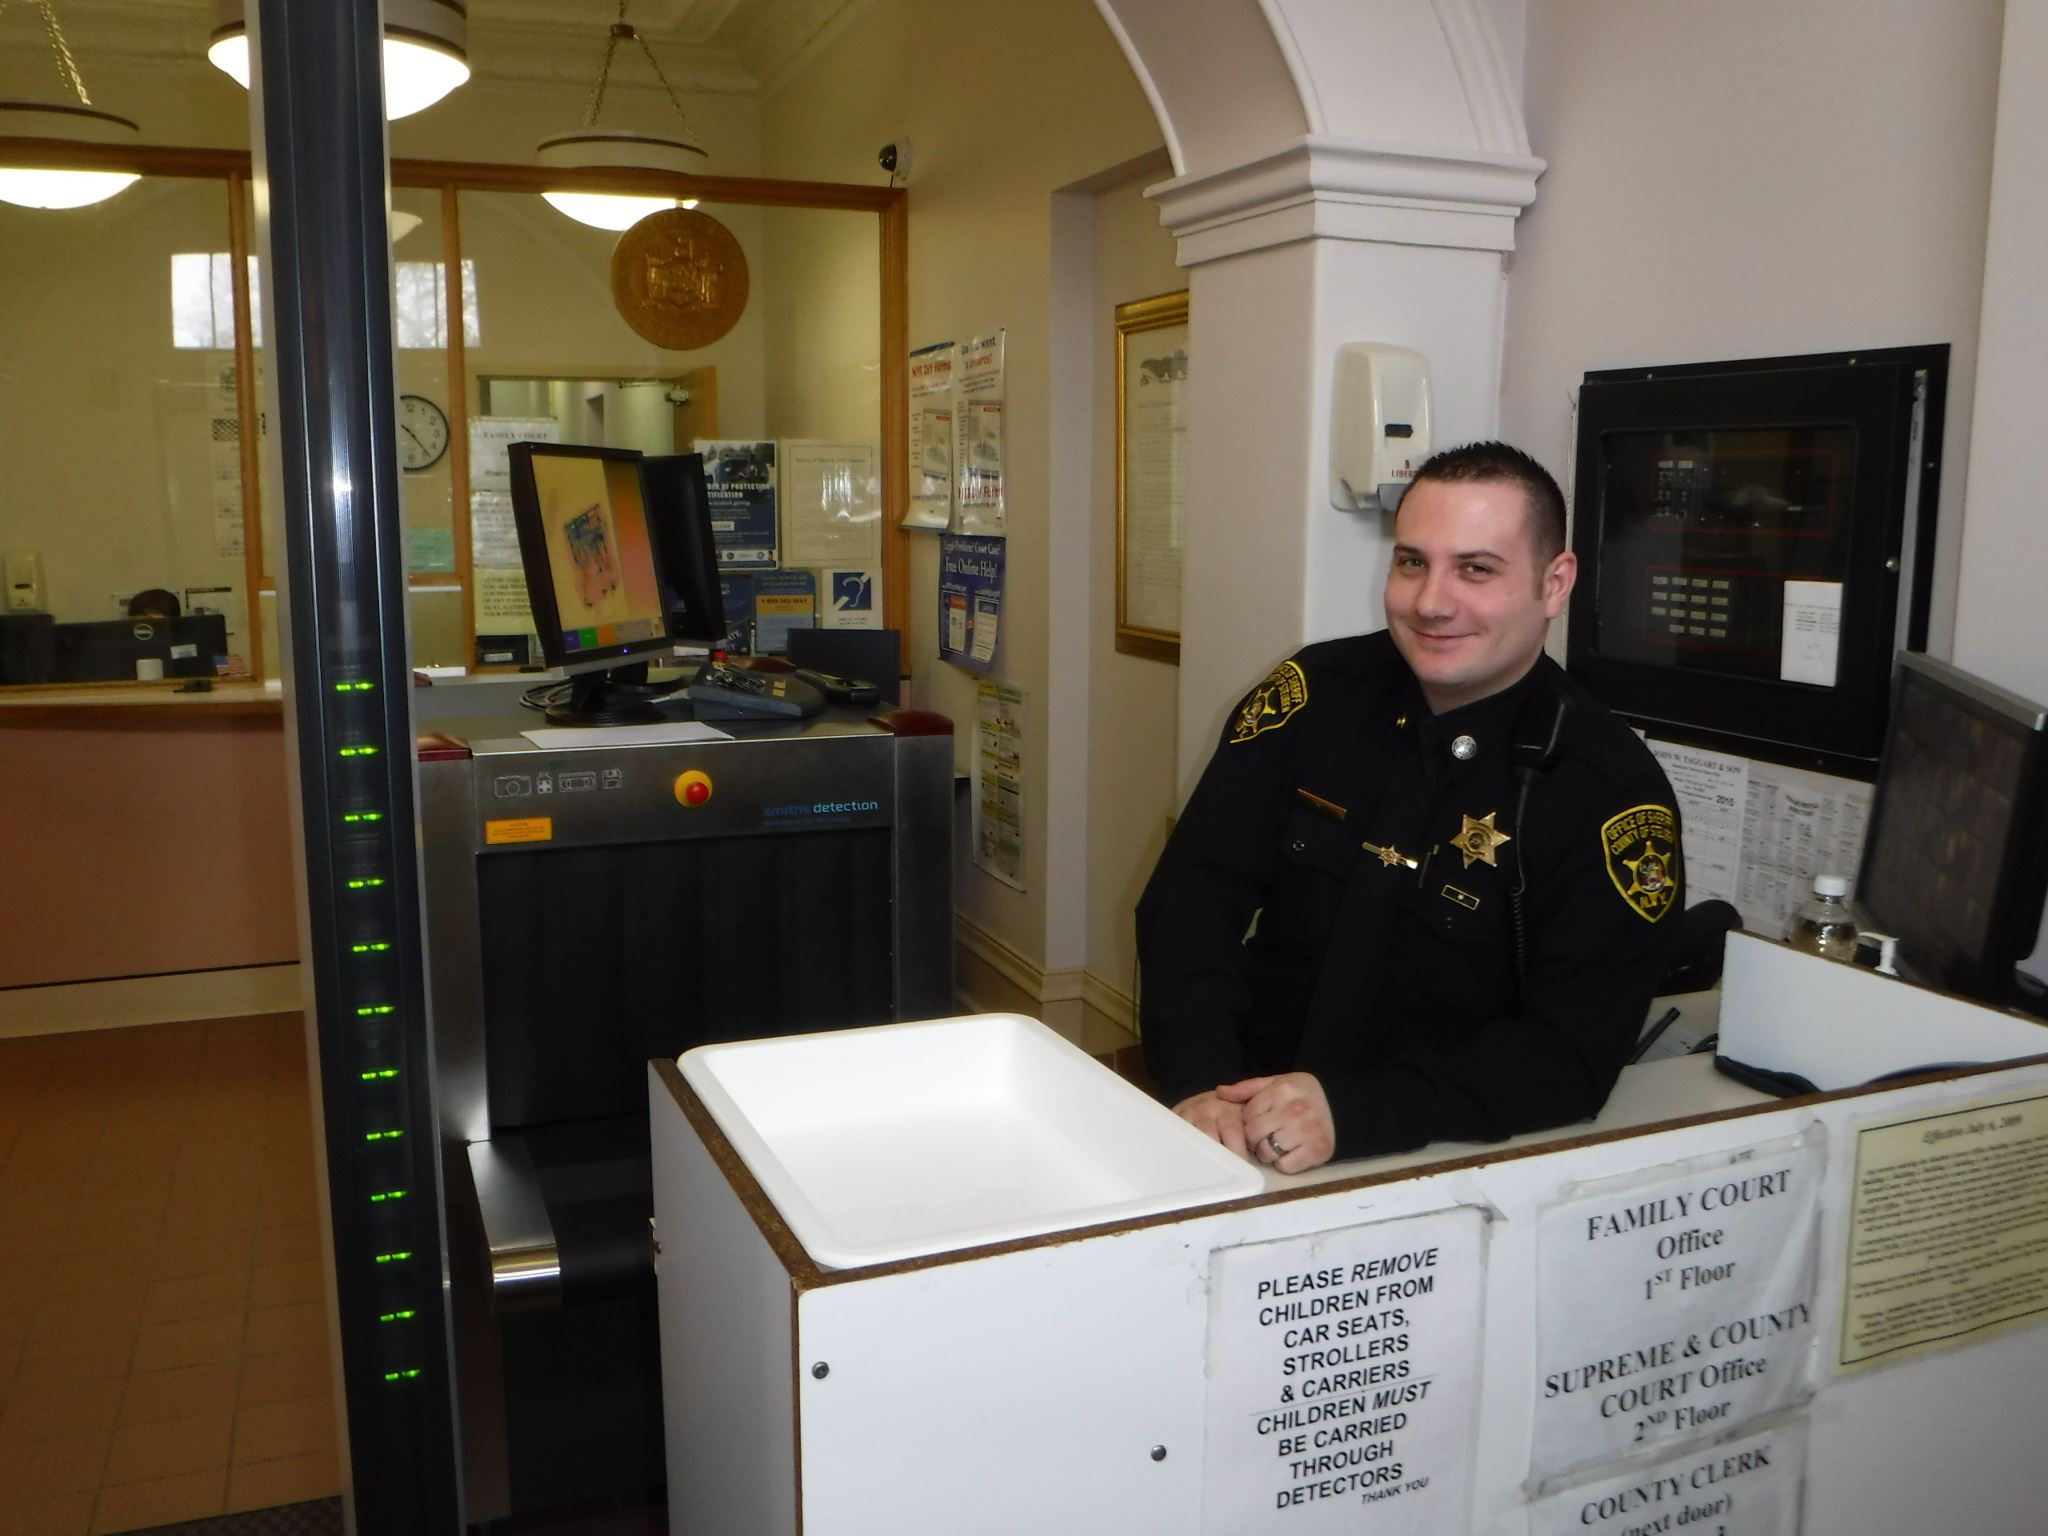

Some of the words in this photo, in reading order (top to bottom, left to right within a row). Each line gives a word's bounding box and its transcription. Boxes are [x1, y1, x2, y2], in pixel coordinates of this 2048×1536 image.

[945, 556, 957, 573] Free
[958, 558, 979, 576] Online
[980, 560, 997, 584] Help!
[813, 801, 878, 813] detection
[1606, 815, 1638, 841] OFFICE
[1610, 829, 1639, 856] COUNTY
[1587, 1192, 1693, 1241] FAMILY
[1700, 1169, 1791, 1212] COURT
[1656, 1228, 1725, 1260] Office
[1257, 1267, 1343, 1300] PLEASE
[1351, 1247, 1438, 1283] REMOVE
[1680, 1260, 1736, 1291] Floor
[1259, 1289, 1369, 1326] CHILDREN
[1376, 1275, 1434, 1304] FROM
[1283, 1324, 1330, 1348] CAR
[1336, 1308, 1410, 1339] SEATS,
[1282, 1334, 1410, 1376] STROLLERS
[1544, 1341, 1676, 1398] SUPREME
[1682, 1334, 1702, 1357] &
[1710, 1302, 1812, 1349] COUNTY
[1280, 1385, 1295, 1404] &
[1302, 1360, 1410, 1399] CARRIERS
[1600, 1371, 1693, 1418] COURT
[1699, 1356, 1768, 1390] Office
[1257, 1395, 1365, 1435] CHILDREN
[1372, 1381, 1432, 1411] MUST
[1674, 1399, 1732, 1431] Floor
[1278, 1435, 1307, 1457] BE
[1314, 1413, 1407, 1448] CARRIED
[1289, 1440, 1393, 1479] THROUGH
[1276, 1463, 1404, 1509] DETECTORS
[1361, 1486, 1401, 1505] THANK
[1404, 1477, 1430, 1495] YOU
[1580, 1472, 1686, 1526] COUNTY
[1691, 1444, 1772, 1489] CLERK
[1677, 1491, 1733, 1526] door)
